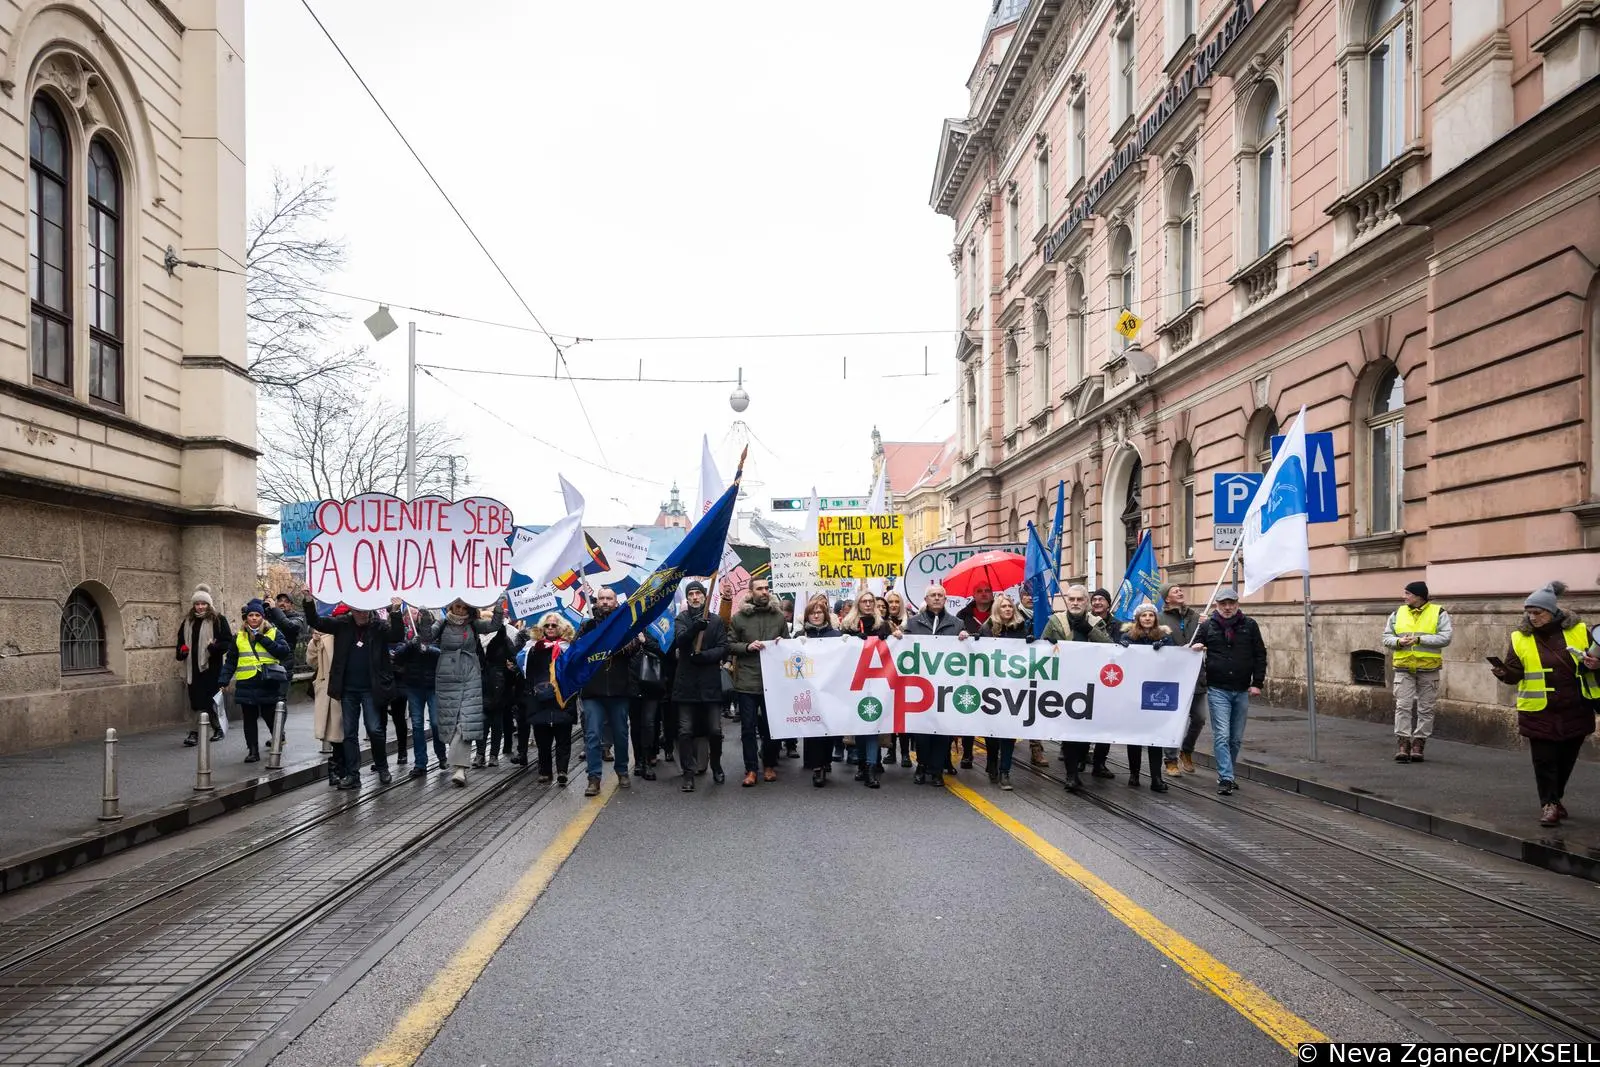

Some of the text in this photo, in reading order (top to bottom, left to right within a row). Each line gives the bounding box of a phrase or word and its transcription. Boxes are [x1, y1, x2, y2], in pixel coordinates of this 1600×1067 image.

[1123, 319, 1136, 330] 10
[1228, 483, 1249, 514] P
[319, 500, 513, 535] OCIJENITE SEBE
[819, 516, 833, 531] AP
[838, 517, 862, 530] MILO
[843, 547, 871, 561] MALO
[882, 532, 894, 546] BI
[308, 538, 513, 594] PA ONDA MENE
[850, 636, 1060, 691] Adventski
[892, 676, 1095, 734] Prosvjed
